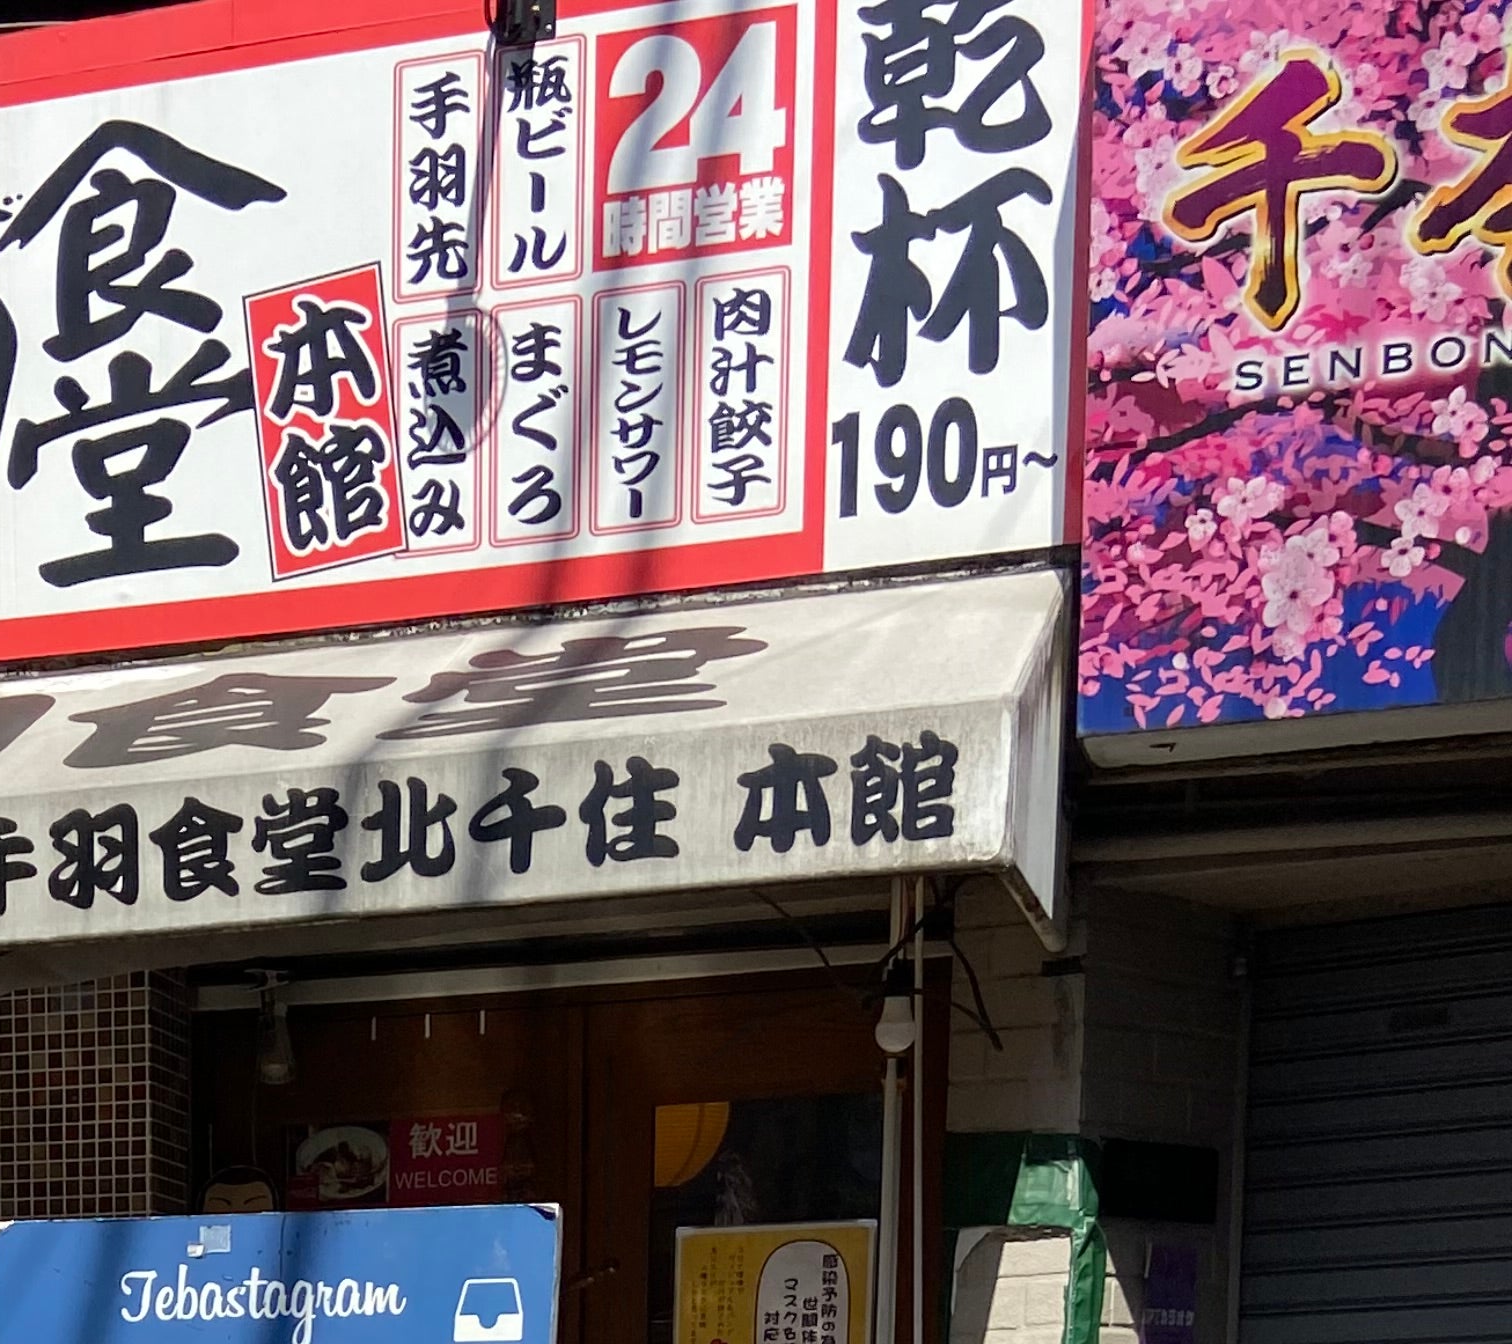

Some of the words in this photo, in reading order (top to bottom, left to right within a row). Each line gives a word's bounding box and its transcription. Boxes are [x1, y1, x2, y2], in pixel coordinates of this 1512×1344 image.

[407, 71, 471, 285] 手羽先
[507, 54, 573, 274] 瓶ビール
[607, 20, 787, 195] 24
[843, 0, 1054, 388] 乾杯
[602, 176, 786, 258] 時間営業
[7, 119, 287, 588] 食堂
[268, 301, 385, 551] 本館
[407, 328, 467, 538] 煮込み
[507, 322, 570, 525] まぐろ
[611, 306, 664, 519] レモンサワー
[707, 287, 775, 507] 肉汁餃子
[734, 734, 960, 854] 本館
[394, 1167, 498, 1190] WELCOME
[408, 1121, 479, 1160] 歓迎
